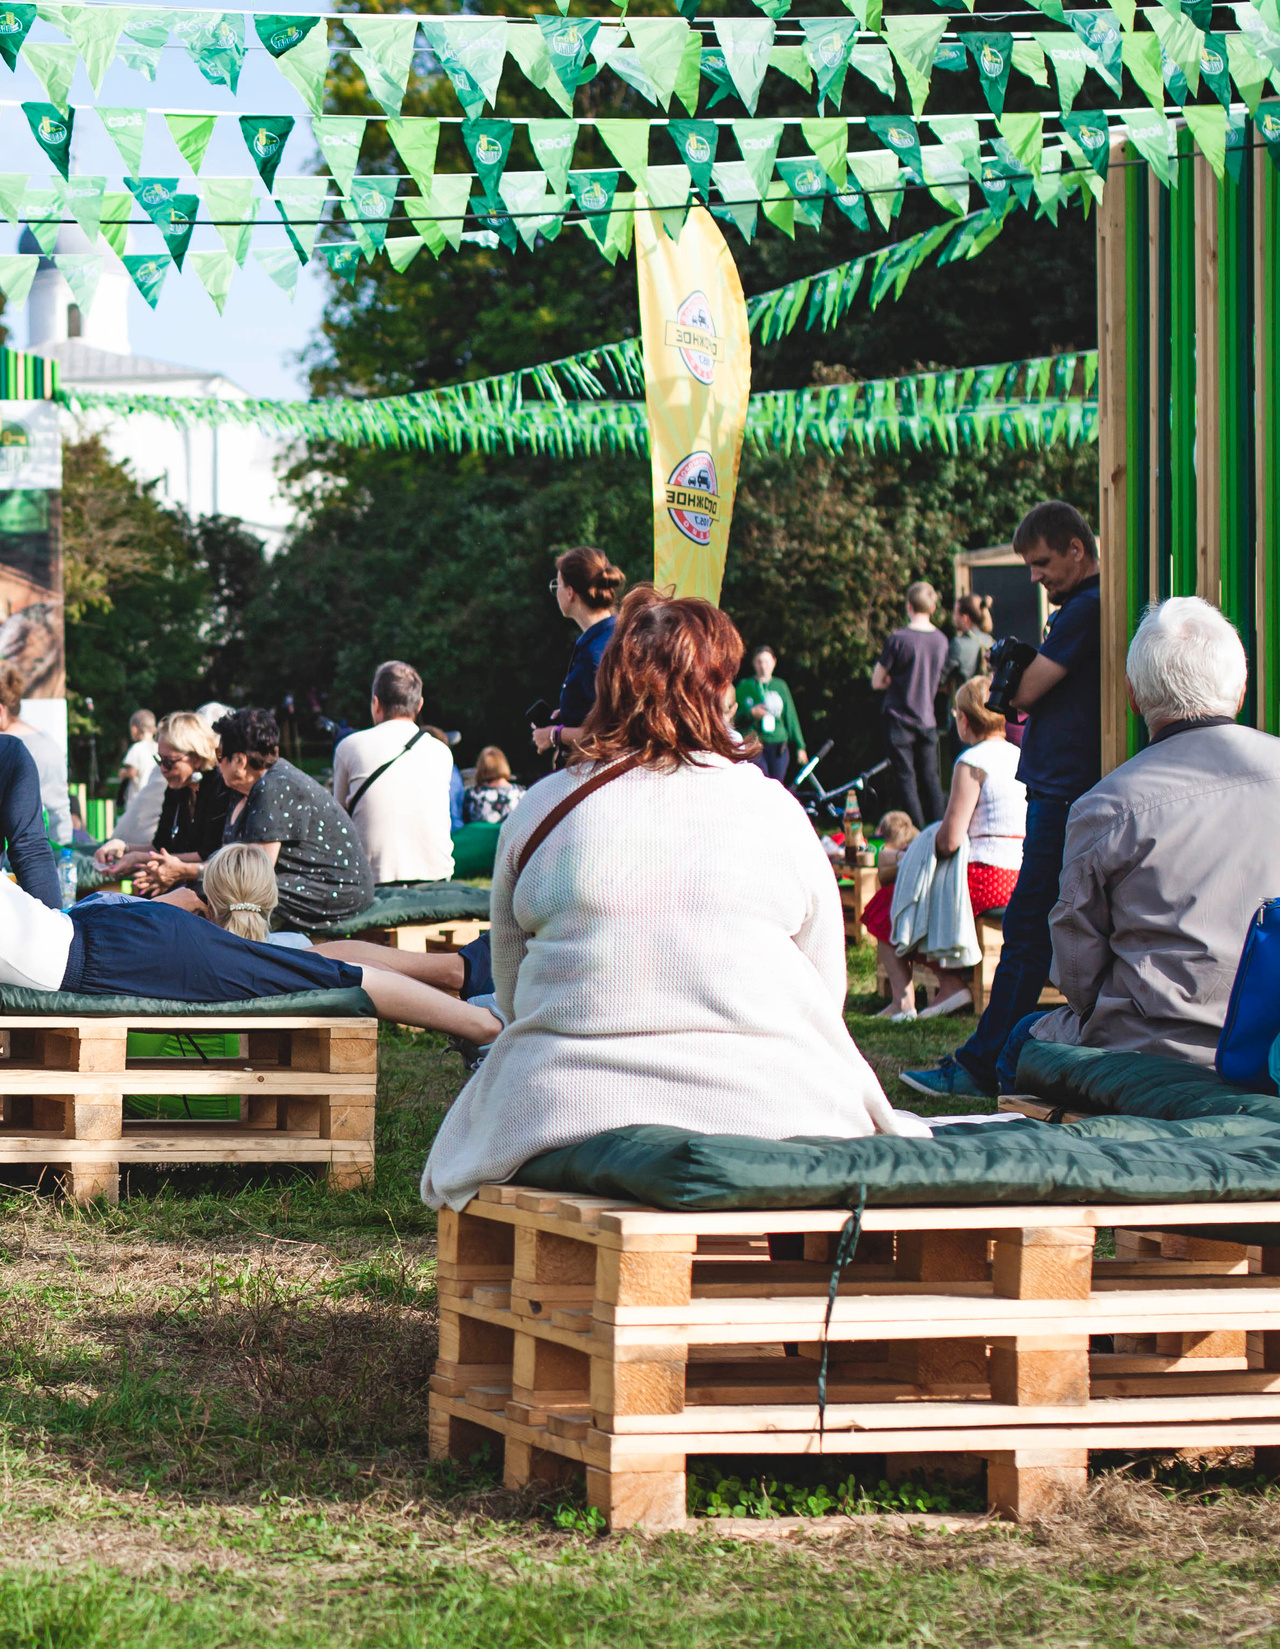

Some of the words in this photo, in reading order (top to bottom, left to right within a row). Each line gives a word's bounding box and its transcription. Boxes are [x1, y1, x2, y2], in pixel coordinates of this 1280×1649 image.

[107, 113, 143, 128] СВОЁ
[322, 131, 358, 146] СВОЁ
[536, 133, 572, 150] СВОЁ
